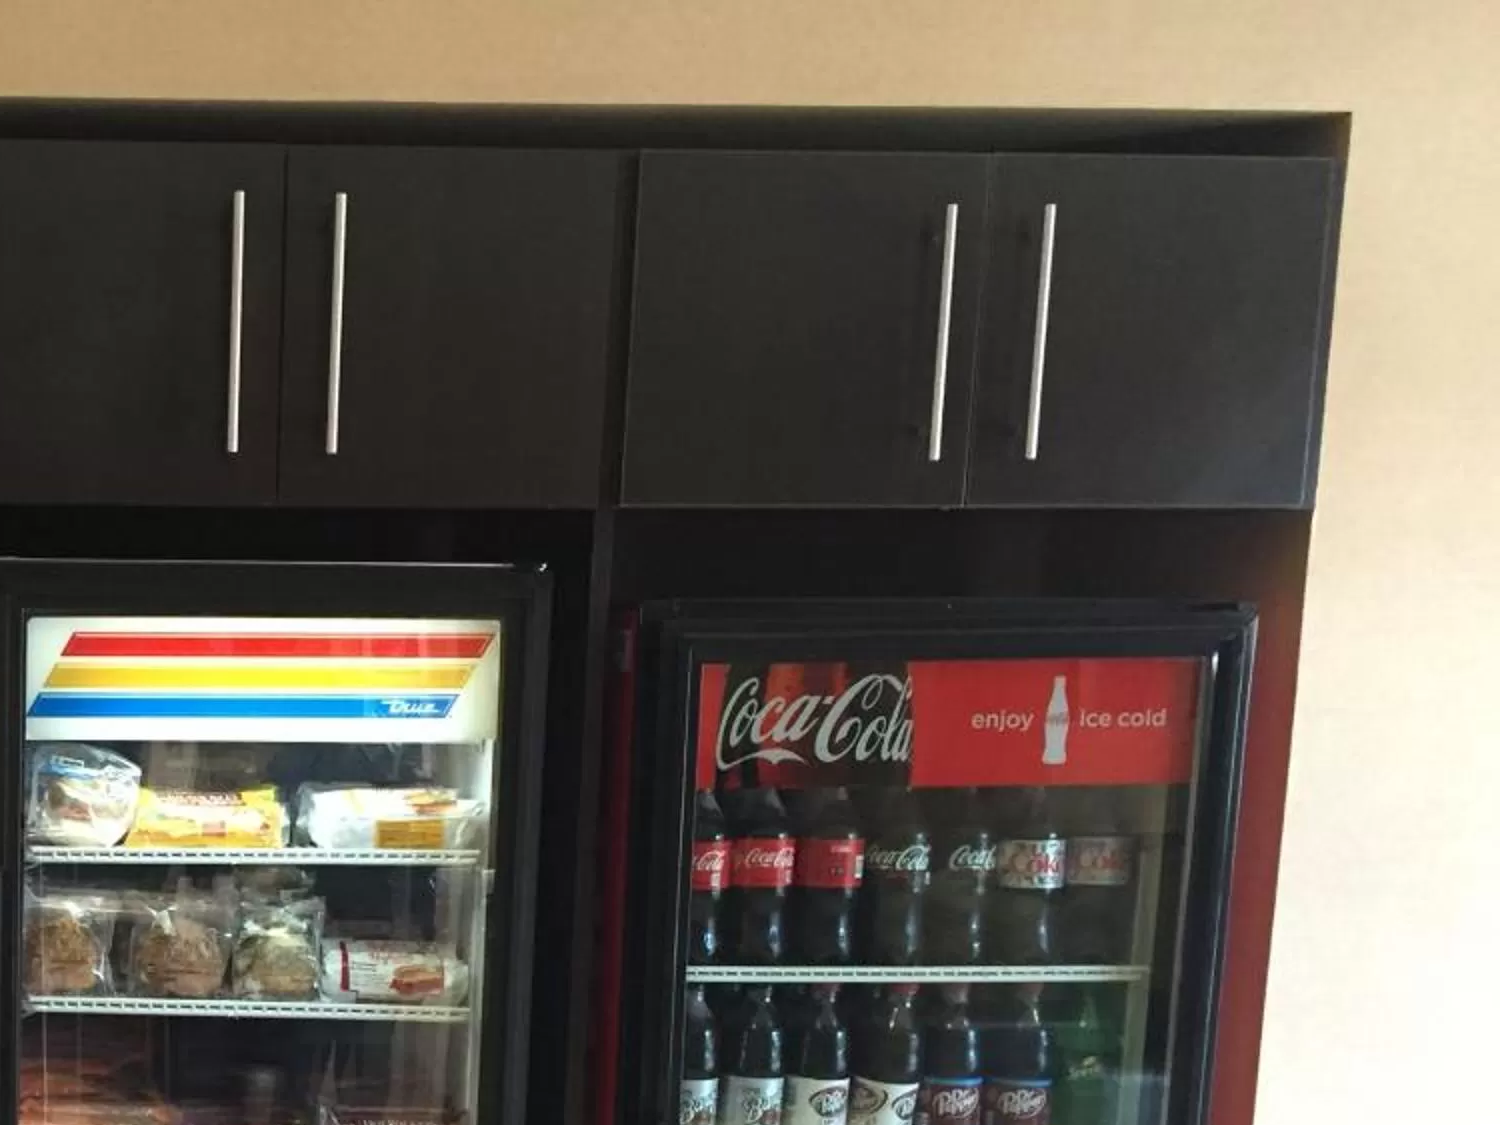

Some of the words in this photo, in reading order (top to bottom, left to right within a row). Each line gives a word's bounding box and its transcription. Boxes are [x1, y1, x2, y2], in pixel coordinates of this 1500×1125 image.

[716, 674, 913, 770] Coca-Cola
[971, 709, 1034, 732] enjoy
[1117, 708, 1167, 727] cold
